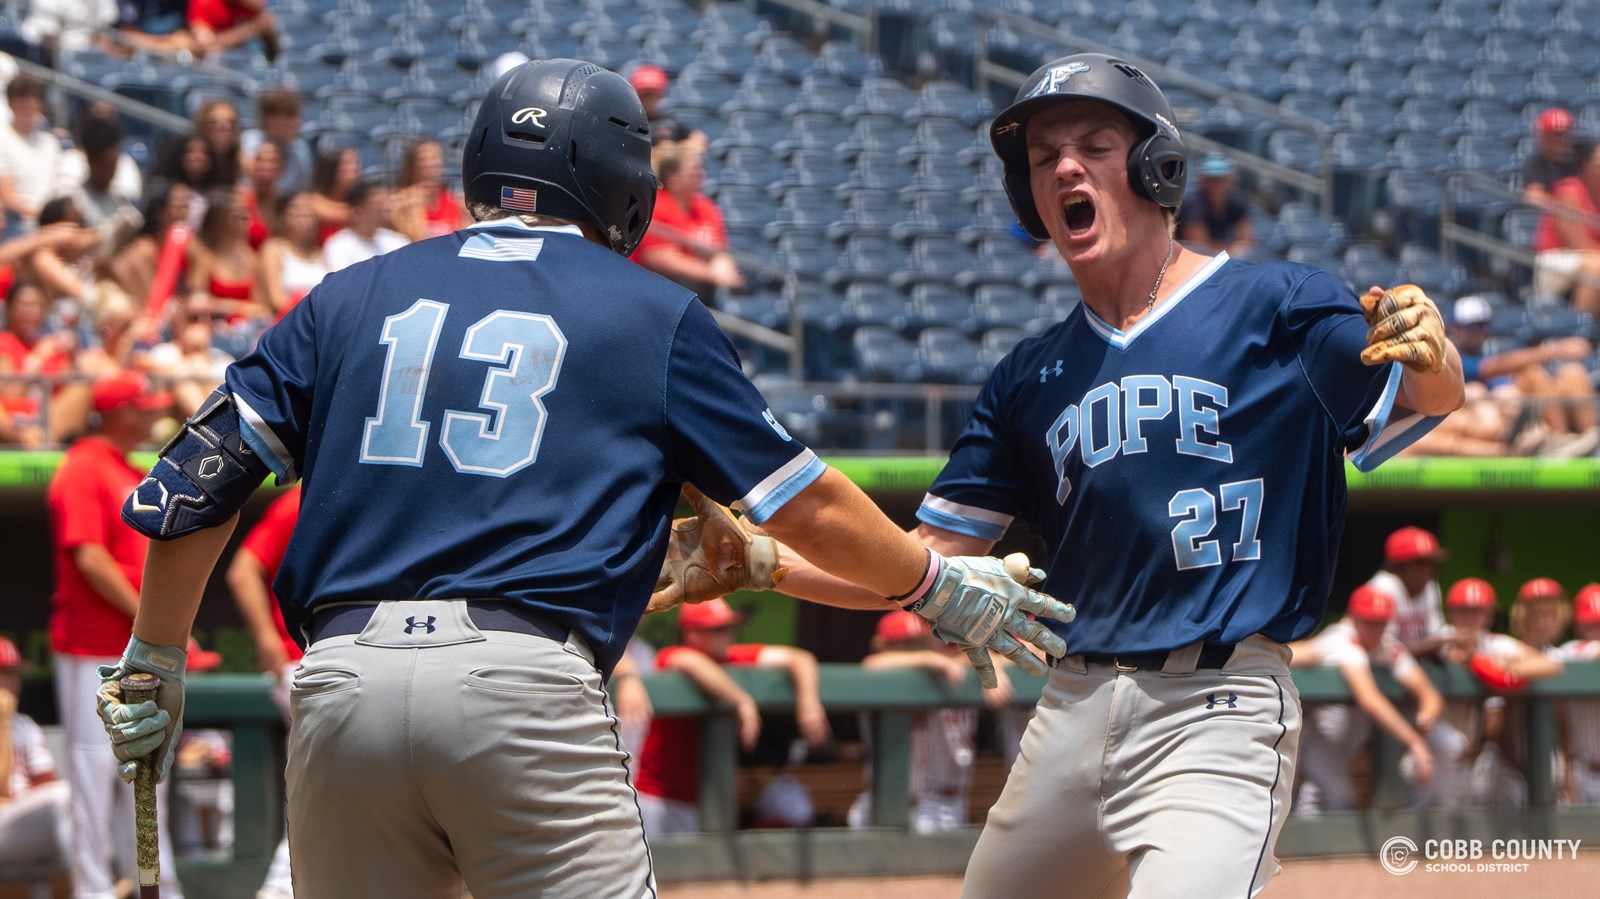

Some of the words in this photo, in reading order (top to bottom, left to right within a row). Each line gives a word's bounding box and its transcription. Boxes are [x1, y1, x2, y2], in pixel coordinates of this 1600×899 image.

[511, 106, 546, 128] R
[360, 298, 568, 478] 13
[1046, 374, 1234, 506] POPE
[1169, 477, 1264, 571] 27
